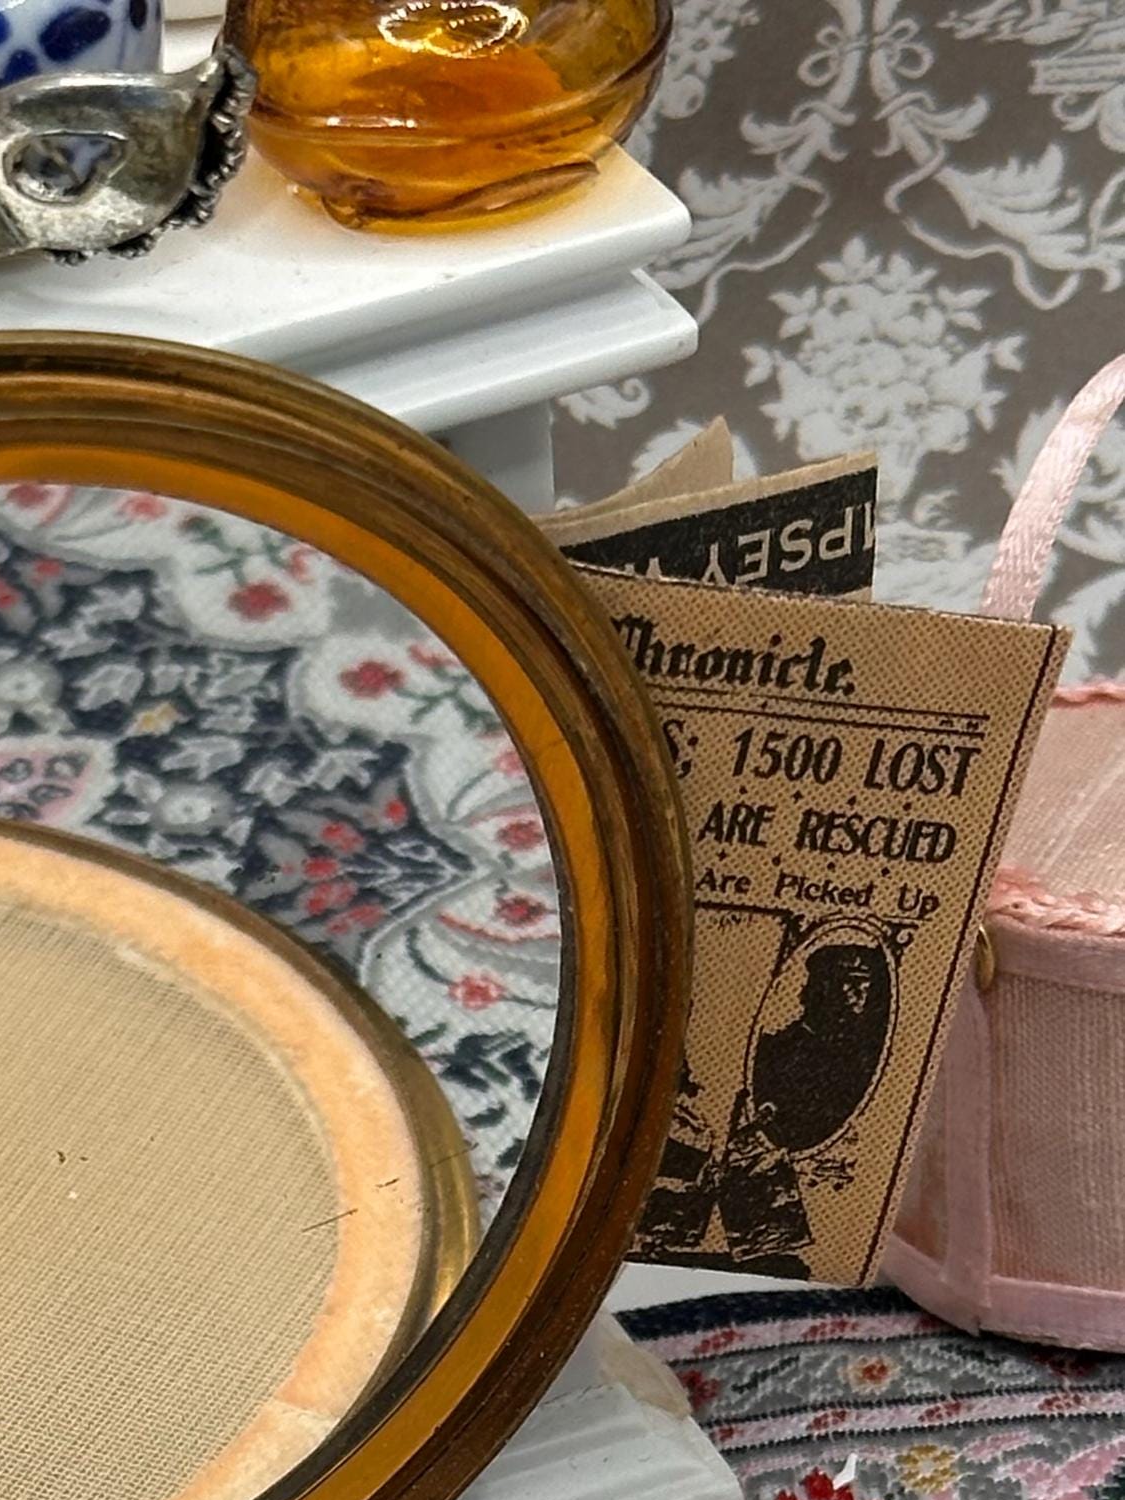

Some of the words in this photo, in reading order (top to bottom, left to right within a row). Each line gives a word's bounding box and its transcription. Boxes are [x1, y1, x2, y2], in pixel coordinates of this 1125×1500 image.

[732, 727, 843, 785] 1500
[864, 738, 982, 798] LOST
[698, 800, 775, 848] ARE
[794, 808, 957, 864] RESCUED
[695, 867, 752, 894] Are
[774, 870, 876, 907] Picked
[898, 882, 941, 921] Up
